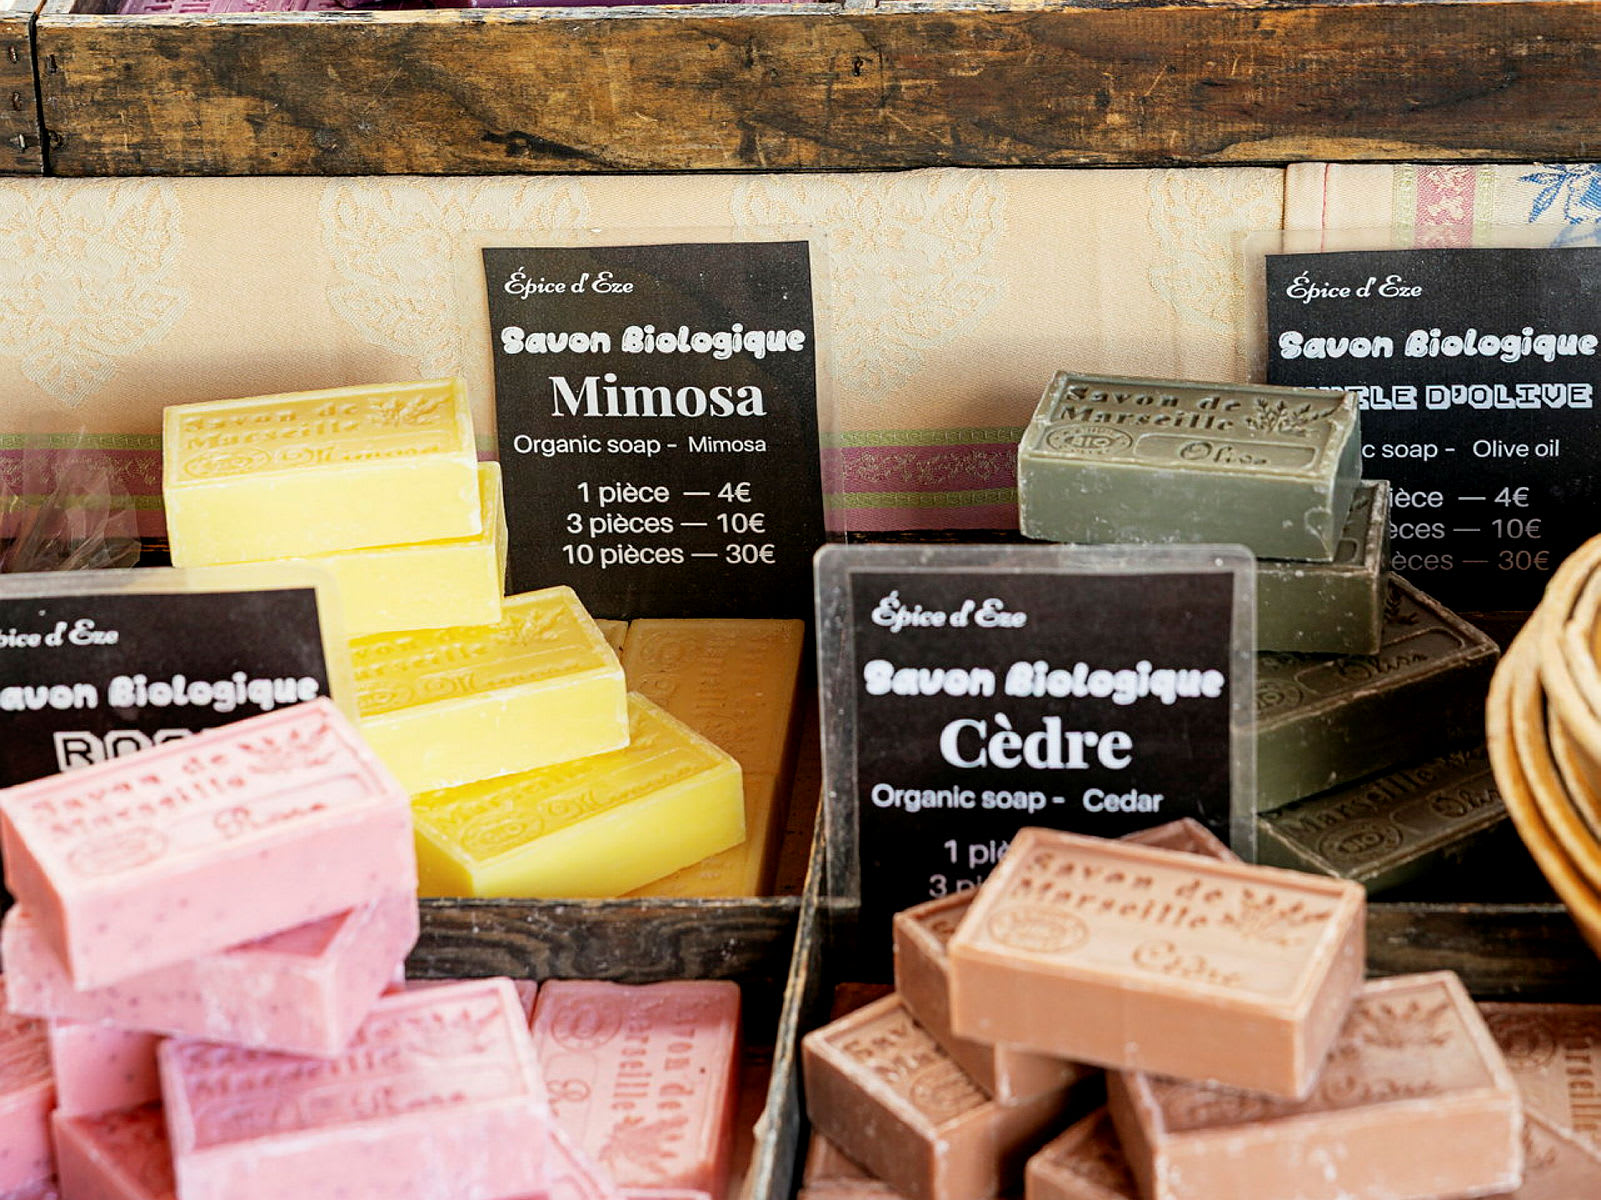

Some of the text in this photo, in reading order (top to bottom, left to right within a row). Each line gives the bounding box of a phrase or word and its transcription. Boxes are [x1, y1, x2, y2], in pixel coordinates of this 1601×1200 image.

[504, 266, 566, 300] Épice
[1286, 270, 1350, 304] Épice
[501, 323, 806, 361] Savon Biologique
[1278, 327, 1599, 363] Savon Biologique
[549, 373, 767, 418] Mimosa
[1064, 384, 1241, 412] Savon de
[1425, 382, 1593, 410] D'OLIVE
[1059, 405, 1235, 431] Marseille
[513, 434, 767, 457] Organic soap Mimosa
[1381, 442, 1438, 461] soap
[1472, 440, 1529, 458] Olive
[1534, 439, 1560, 458] oil
[577, 482, 752, 507] 1 pièce 4€
[1389, 486, 1530, 508] ièce 4€
[566, 513, 766, 538] 3 pièces 10€
[1491, 518, 1542, 539] 10€
[562, 544, 776, 569] 10 pièces 30€
[1498, 550, 1550, 571] 30€
[871, 590, 946, 633] Épice
[0, 671, 319, 713] avon Biologique
[863, 659, 996, 696] Savon
[1004, 659, 1225, 705] Biologique
[939, 712, 1133, 770] Cèdre
[871, 783, 1164, 814] Organic soap Cedar
[944, 839, 957, 864] 1
[929, 873, 947, 898] 3
